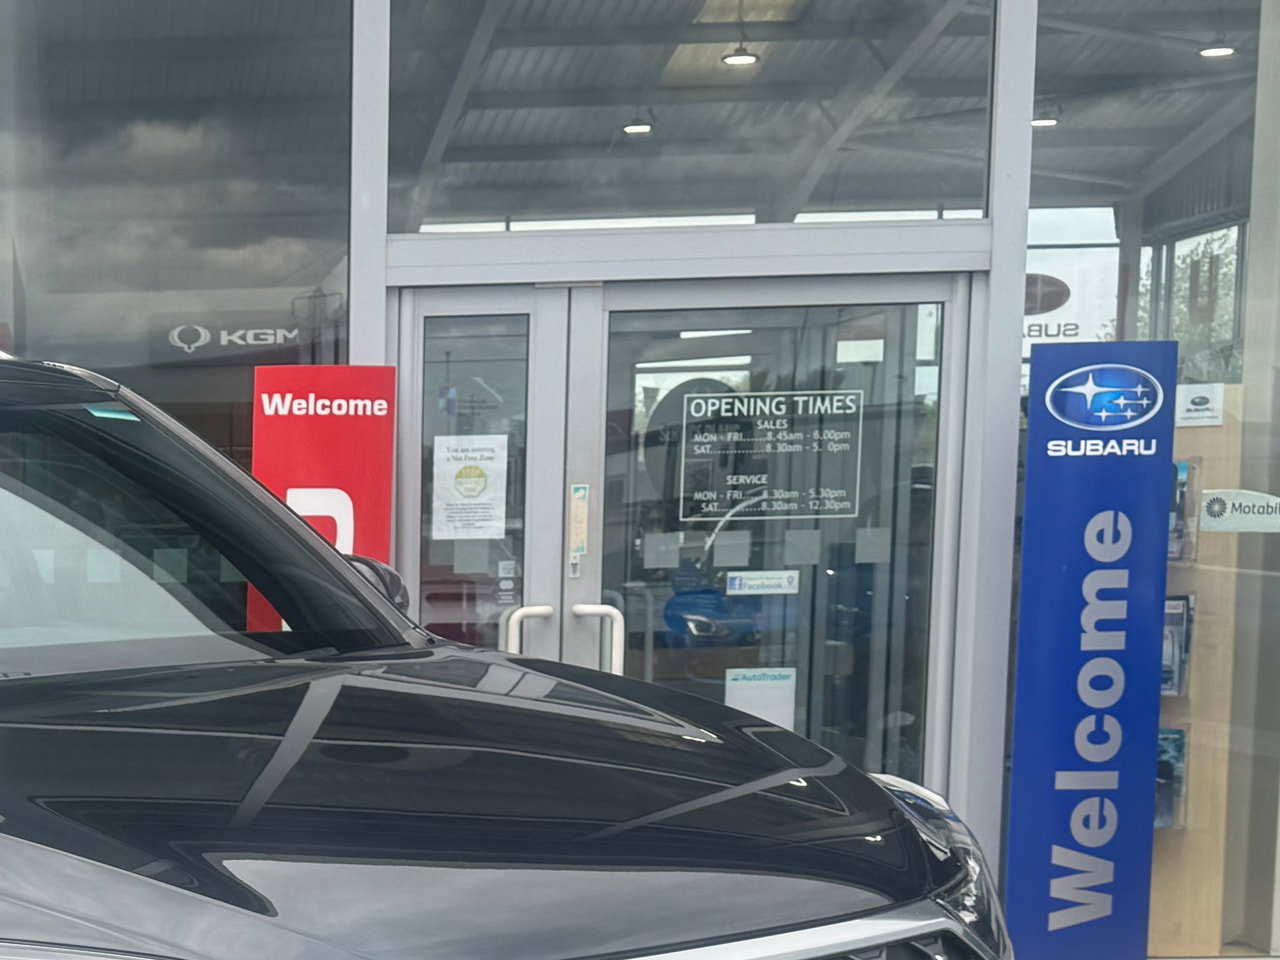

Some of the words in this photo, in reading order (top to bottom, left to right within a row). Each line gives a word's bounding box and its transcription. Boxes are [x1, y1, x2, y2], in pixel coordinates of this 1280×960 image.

[221, 328, 298, 345] KGM
[261, 393, 388, 416] Welcome
[690, 397, 786, 417] OPENING
[793, 395, 857, 415] TIMES
[756, 419, 788, 429] SALES
[694, 432, 717, 442] MON
[1047, 439, 1157, 456] SUBARU
[726, 474, 768, 485] SERVICE
[693, 491, 717, 500] MON
[808, 500, 851, 511] 12.30pm
[1048, 510, 1132, 931] Welcome
